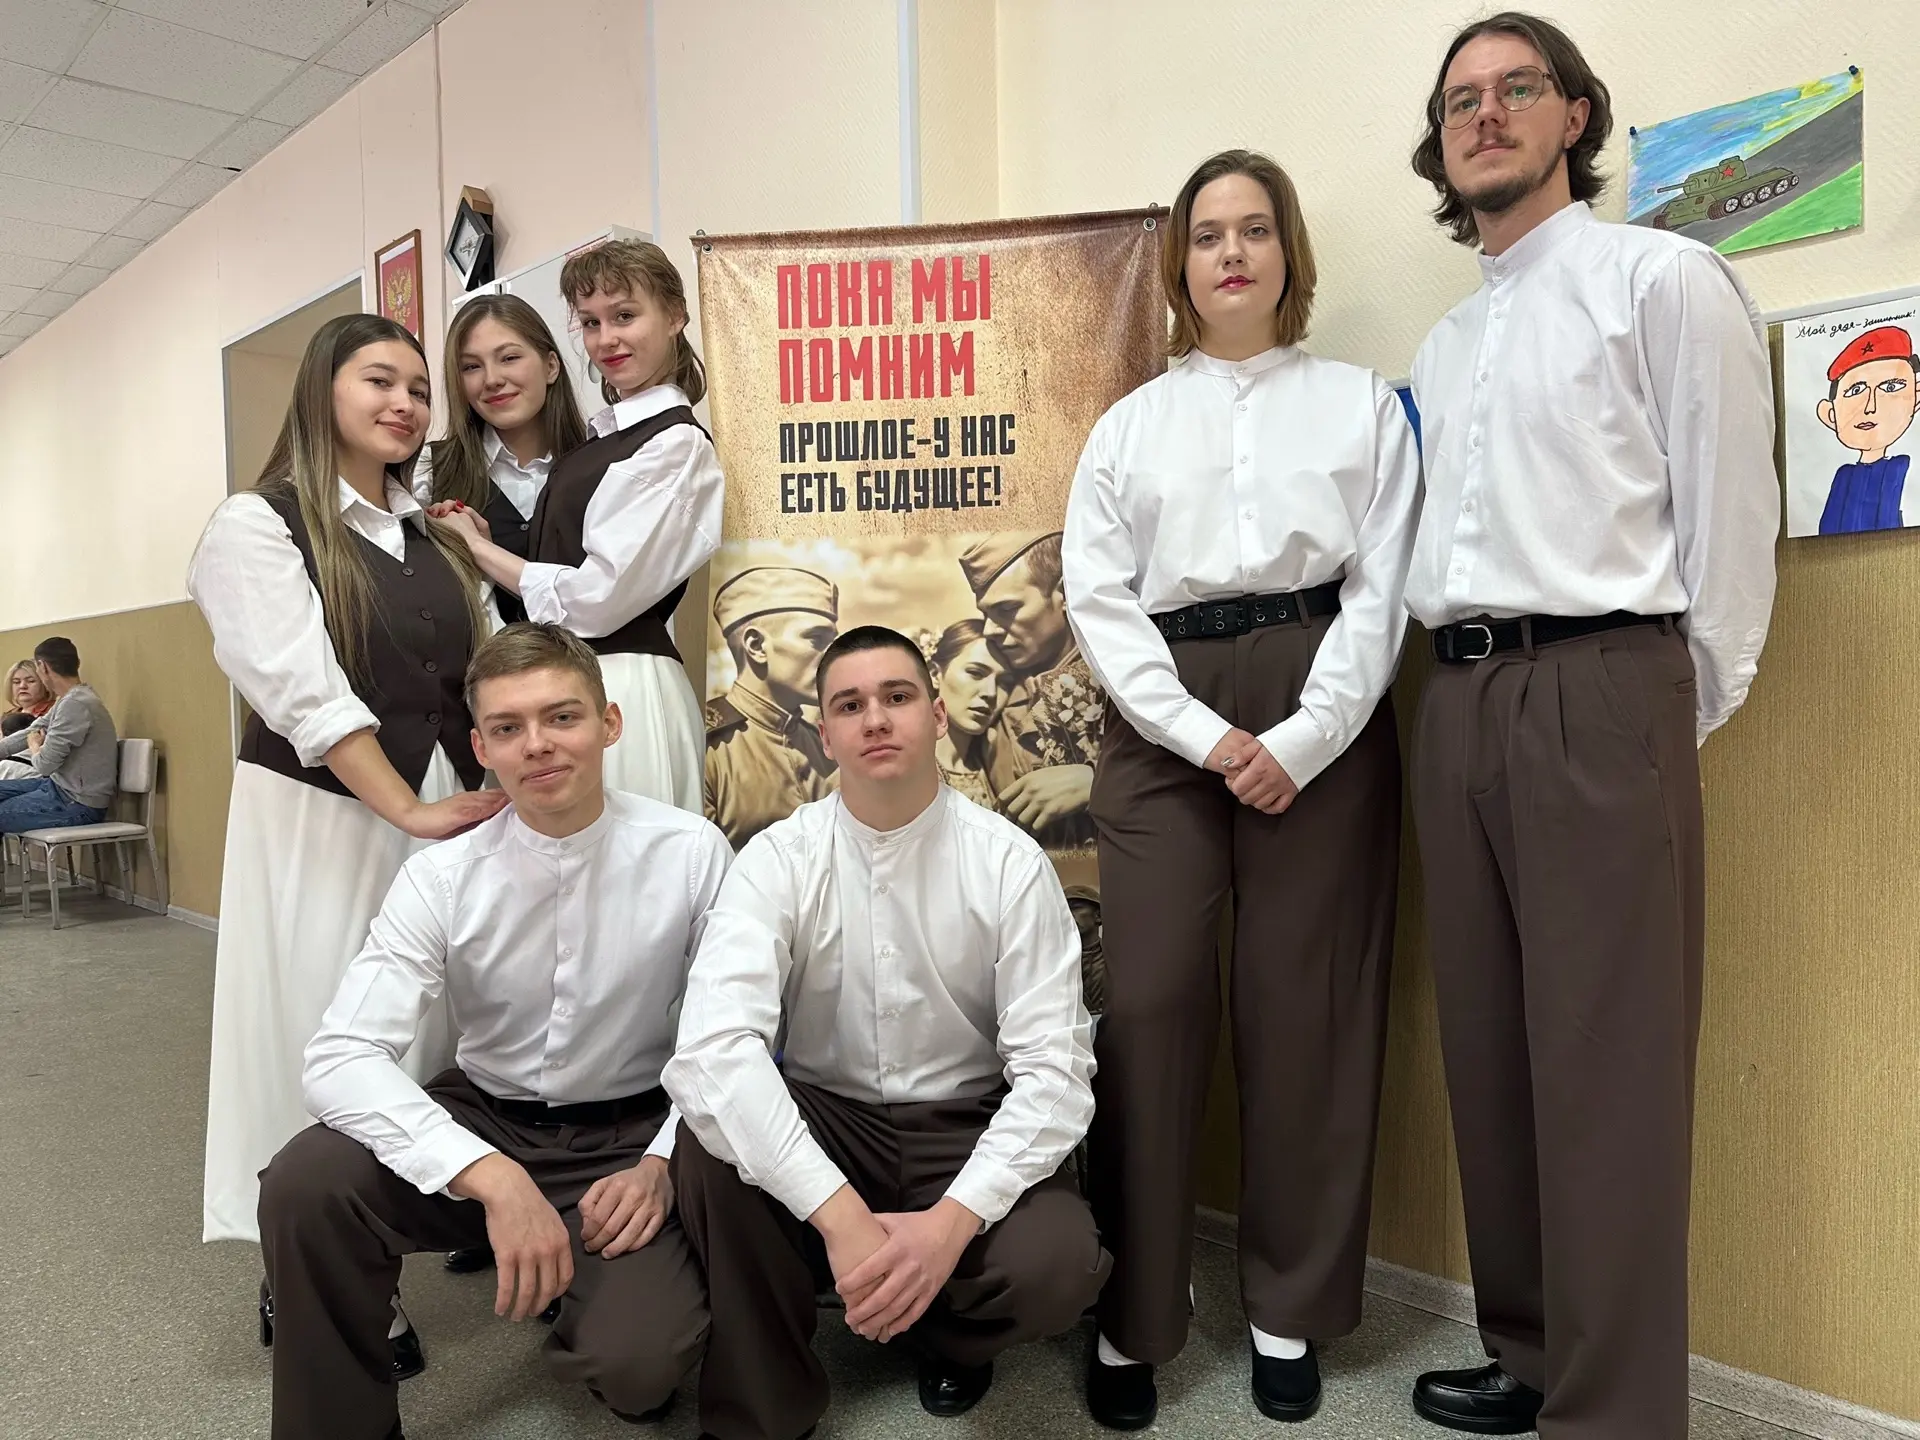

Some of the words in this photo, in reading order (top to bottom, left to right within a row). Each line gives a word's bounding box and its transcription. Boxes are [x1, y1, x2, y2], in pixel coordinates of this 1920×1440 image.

[777, 260, 893, 329] ПОКА
[911, 254, 991, 324] МЫ
[1795, 323, 1827, 339] Мой
[779, 331, 975, 404] ПОМНИМ
[961, 414, 1015, 457] НАС
[781, 471, 846, 514] ЕСТЬ
[856, 465, 1001, 514] БУДУЩЕЕ!
